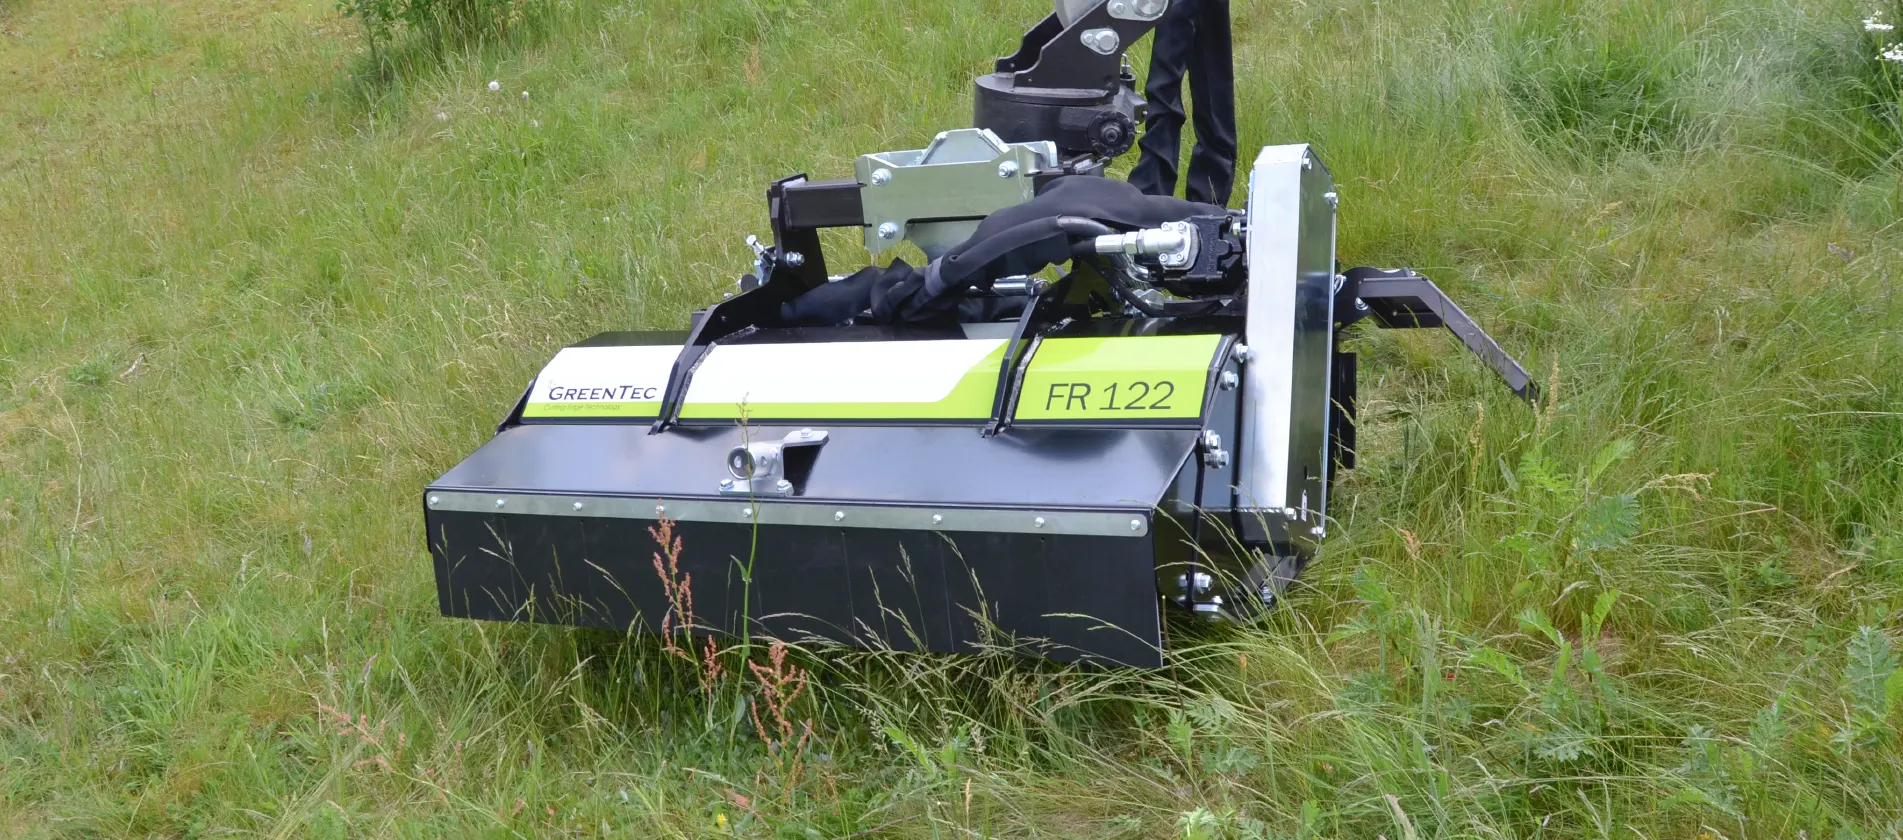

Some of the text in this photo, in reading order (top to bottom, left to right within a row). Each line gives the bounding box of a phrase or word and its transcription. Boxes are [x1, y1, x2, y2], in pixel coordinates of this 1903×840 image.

[1045, 380, 1175, 411] FR 122
[543, 403, 566, 412] Cutting
[584, 403, 621, 411] Technology
